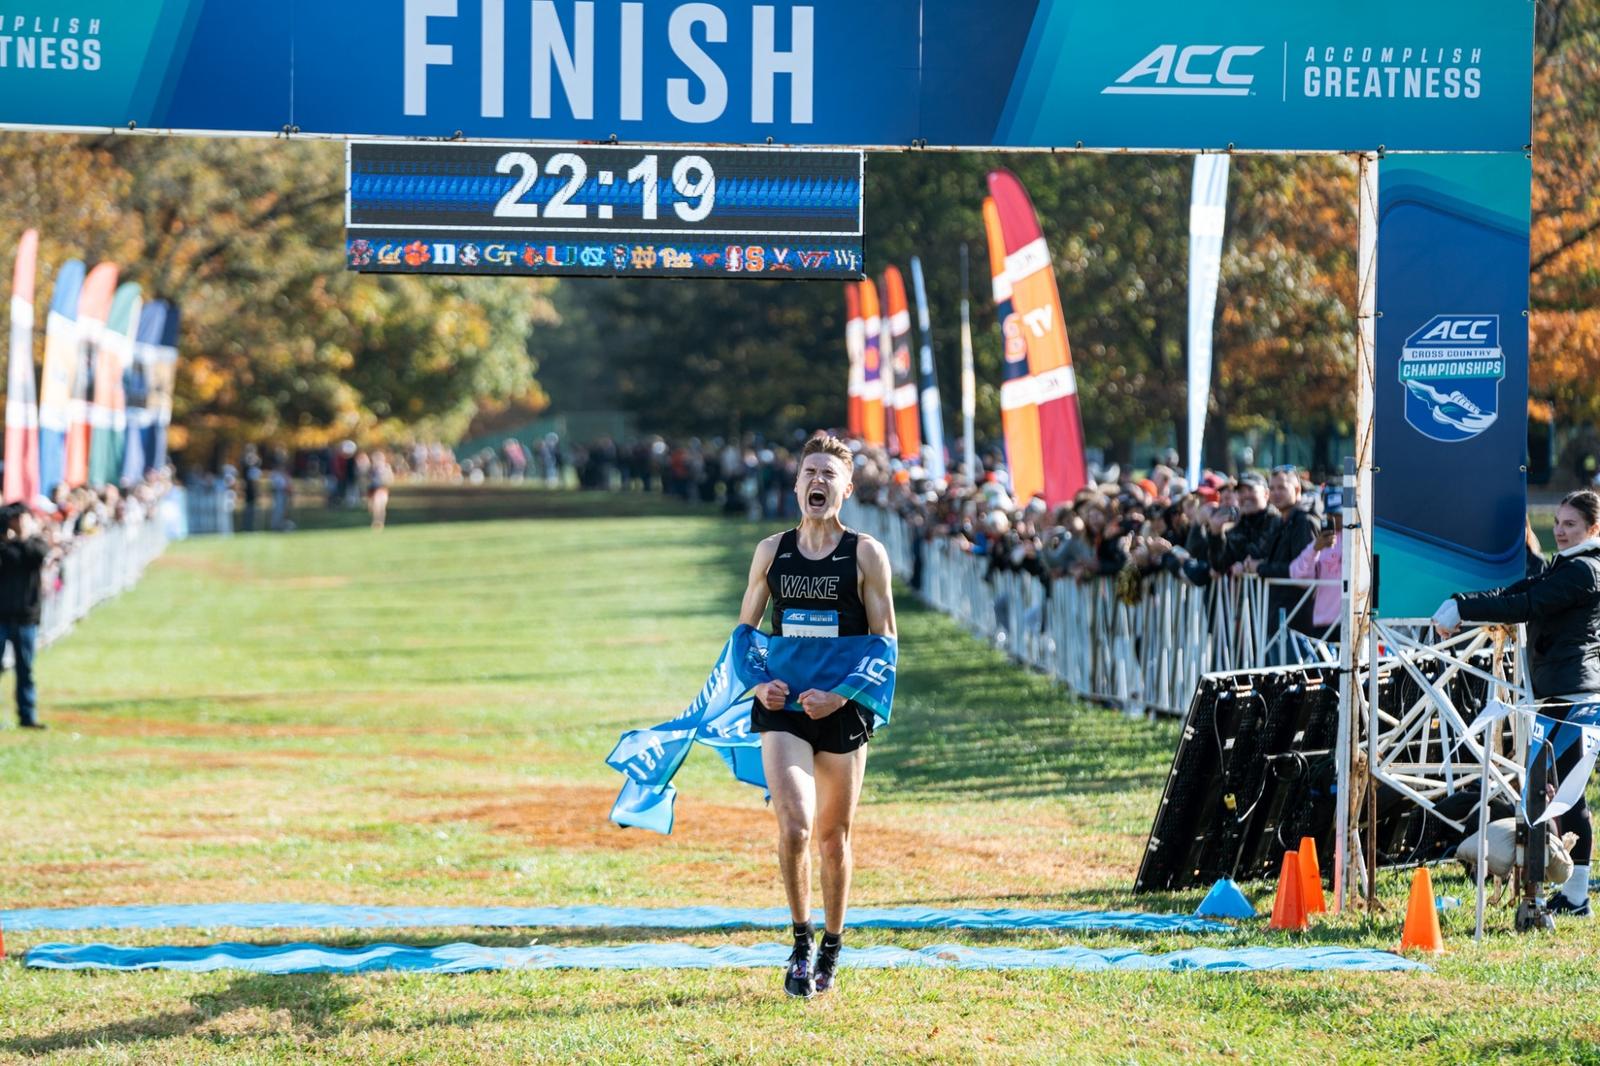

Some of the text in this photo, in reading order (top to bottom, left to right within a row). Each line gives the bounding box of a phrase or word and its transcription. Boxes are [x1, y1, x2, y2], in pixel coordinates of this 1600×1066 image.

[403, 0, 815, 123] FINISH
[1114, 44, 1266, 85] ACC
[1305, 46, 1482, 64] ACCOMPLISH
[1303, 65, 1482, 99] GREATNESS
[492, 151, 717, 223] 22:19
[1421, 320, 1493, 340] ACC
[1411, 350, 1492, 359] CROSS COUNTRY
[1403, 361, 1501, 377] CHAMPIONSHIPS
[780, 574, 840, 601] WAKE
